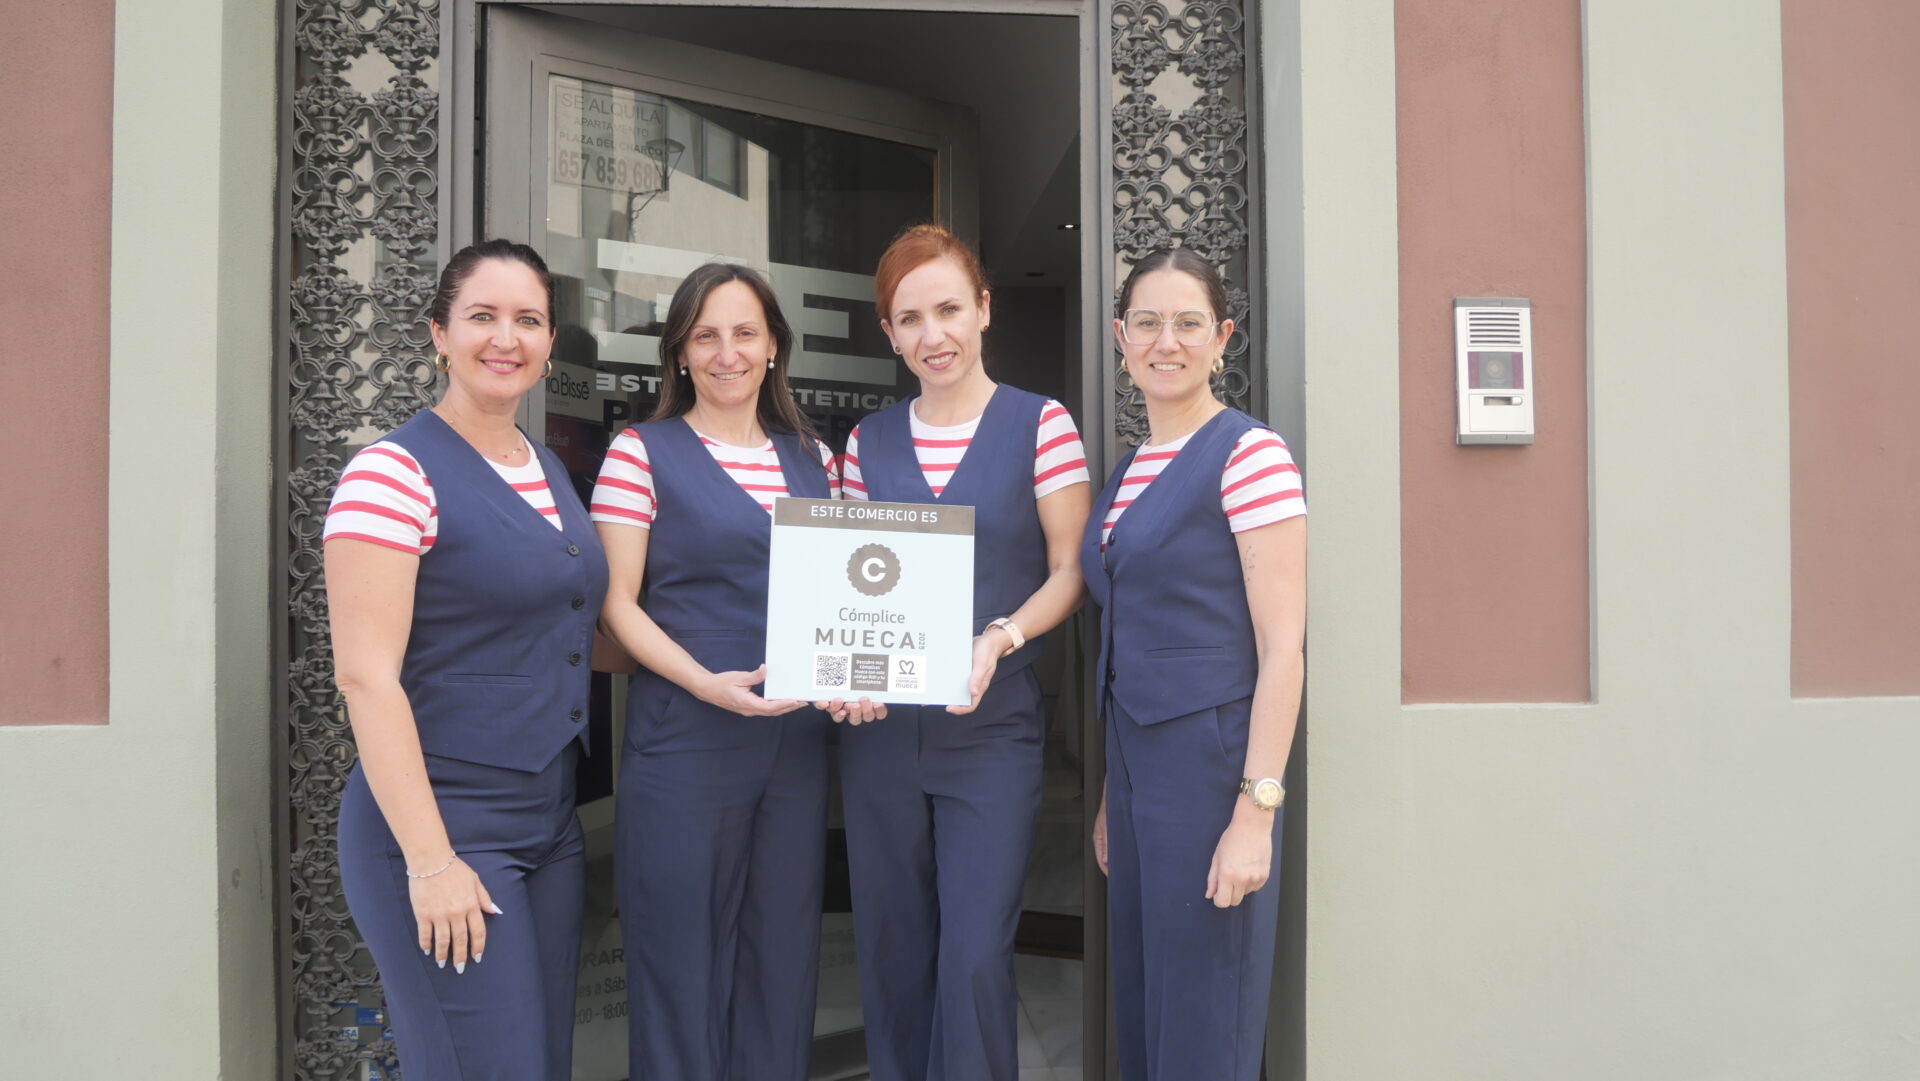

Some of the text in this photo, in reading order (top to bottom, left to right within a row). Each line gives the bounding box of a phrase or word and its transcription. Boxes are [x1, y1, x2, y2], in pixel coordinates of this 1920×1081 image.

[561, 93, 662, 125] SE ALQUILA
[559, 131, 594, 146] PLAZA
[596, 137, 615, 149] DEL
[559, 150, 591, 180] 657
[596, 155, 627, 186] 859
[811, 505, 938, 523] ESTE COMERCIO ES
[861, 557, 887, 583] C
[839, 607, 905, 626] Cómplice
[815, 627, 916, 650] MUECA
[604, 976, 625, 994] Sáb
